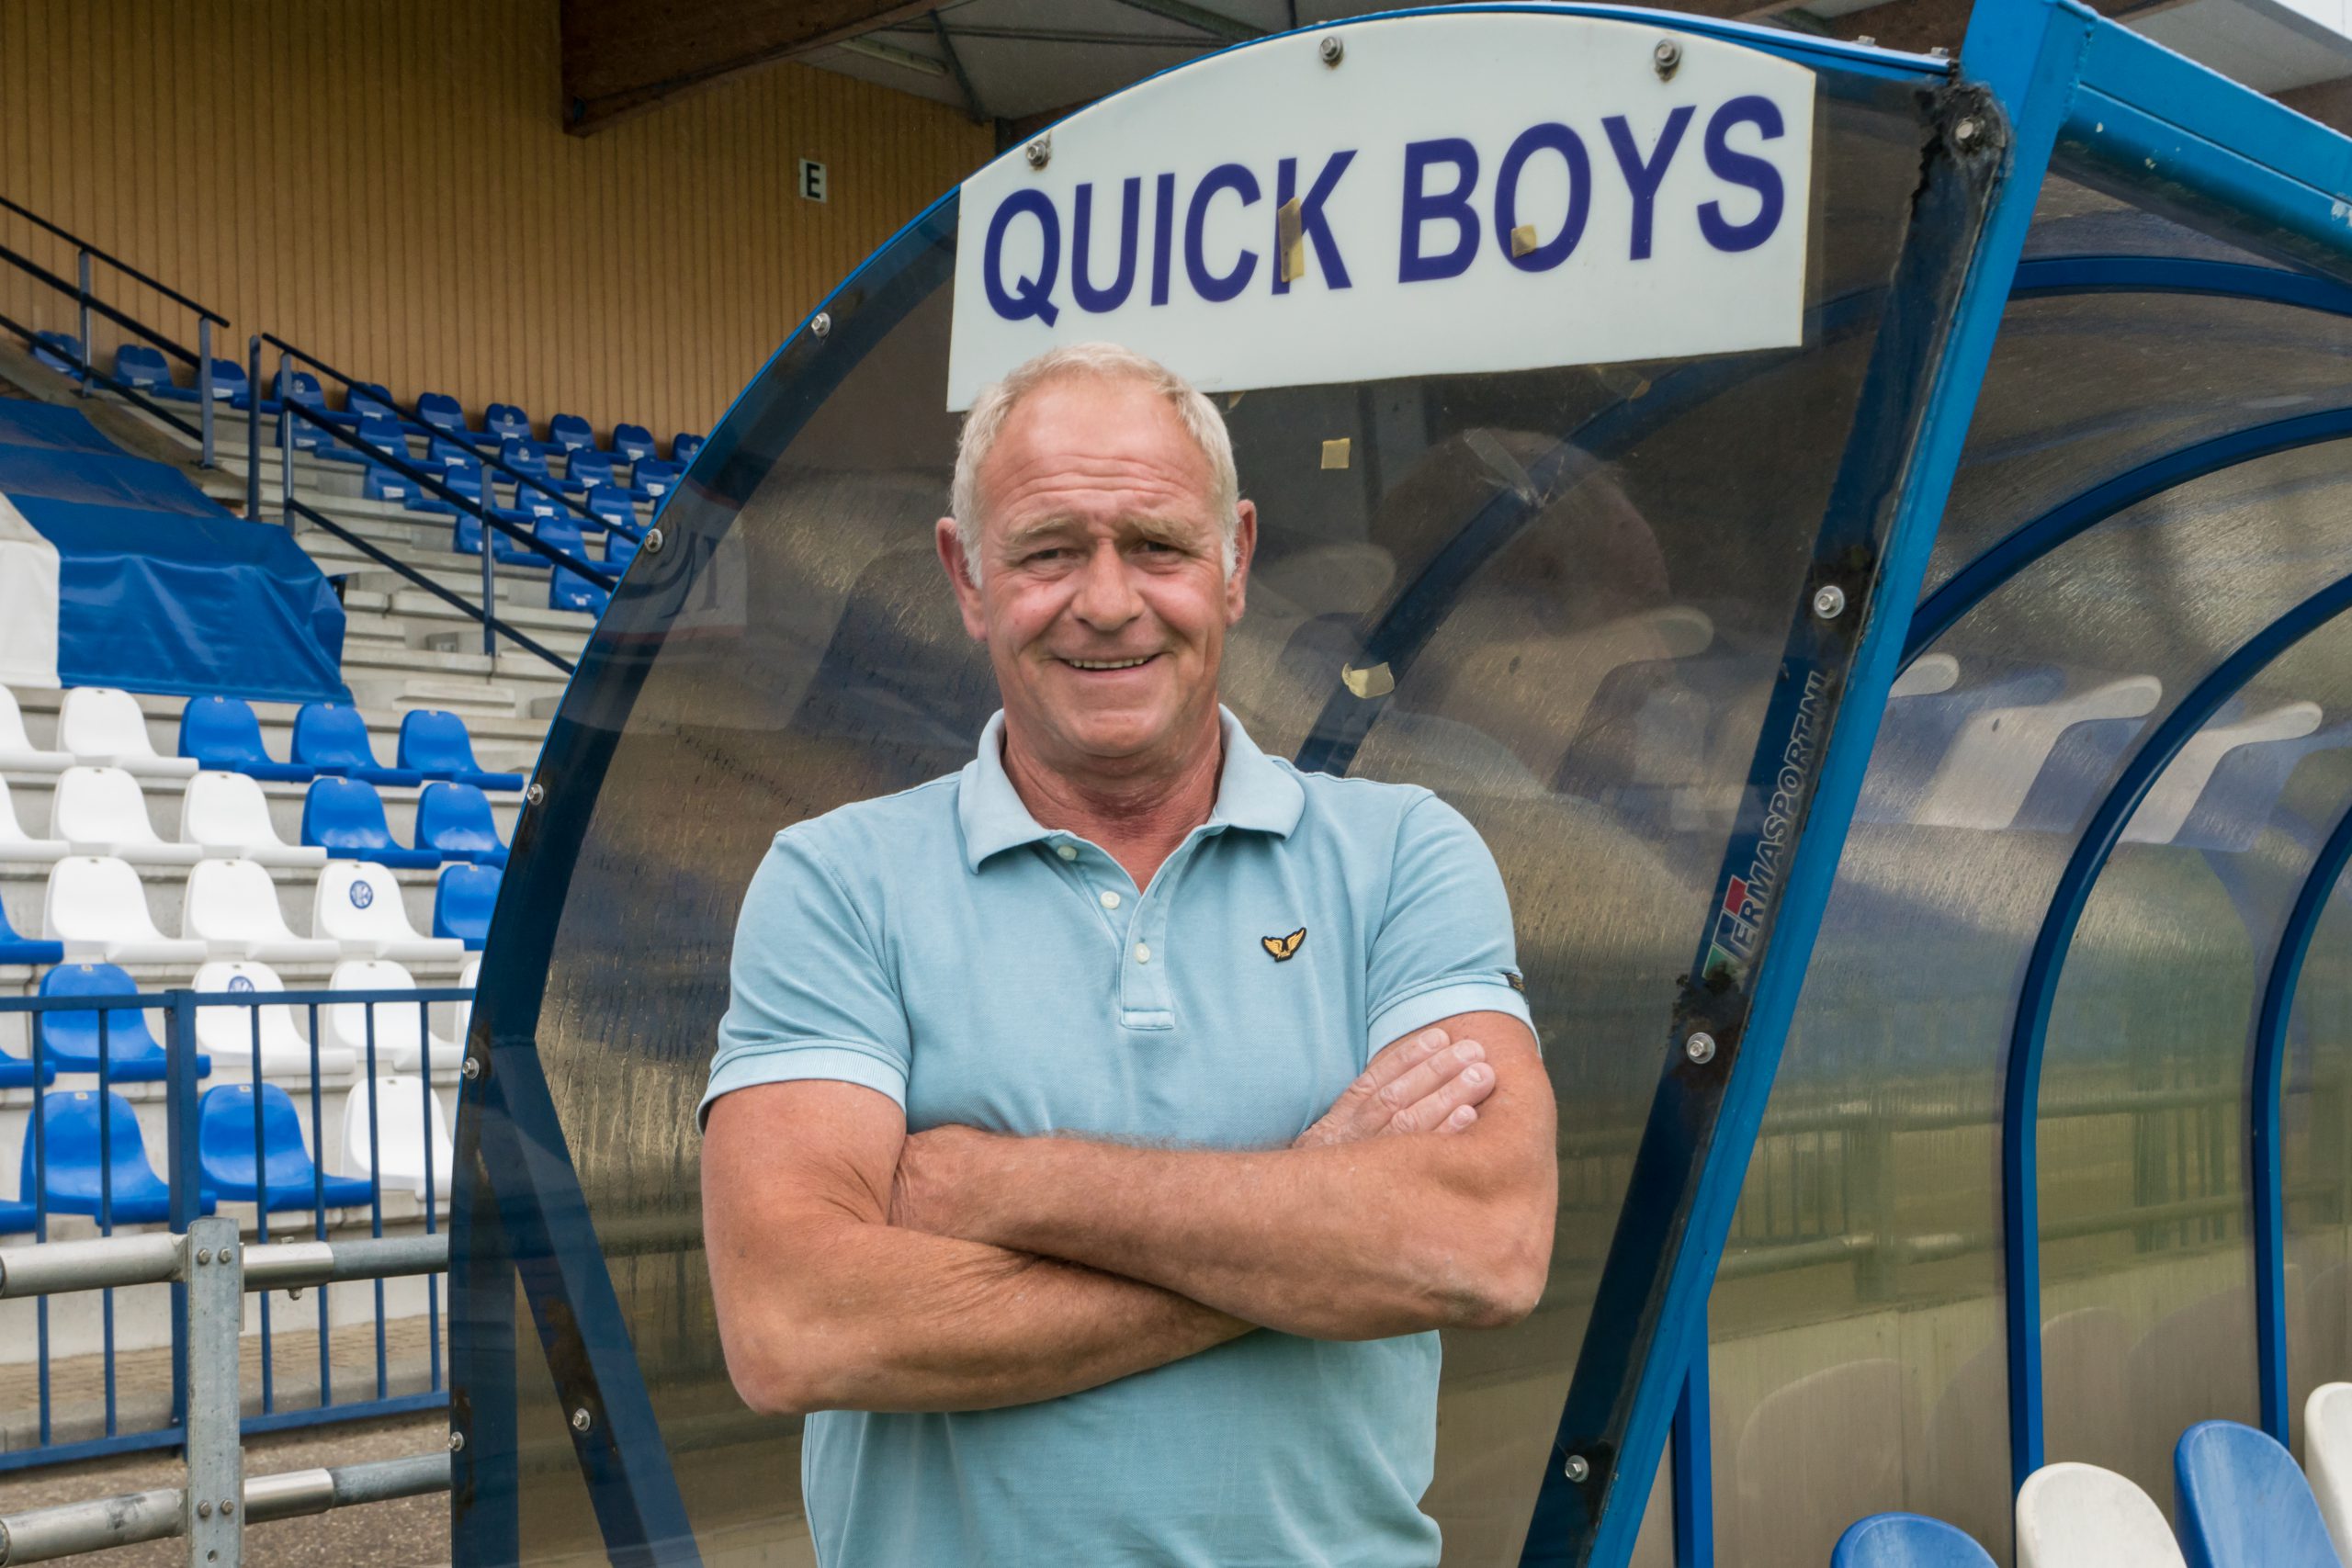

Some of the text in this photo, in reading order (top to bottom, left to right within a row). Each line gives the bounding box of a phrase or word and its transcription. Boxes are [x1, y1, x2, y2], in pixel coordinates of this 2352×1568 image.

[806, 162, 821, 199] E
[984, 95, 1785, 327] QUICK BOYS
